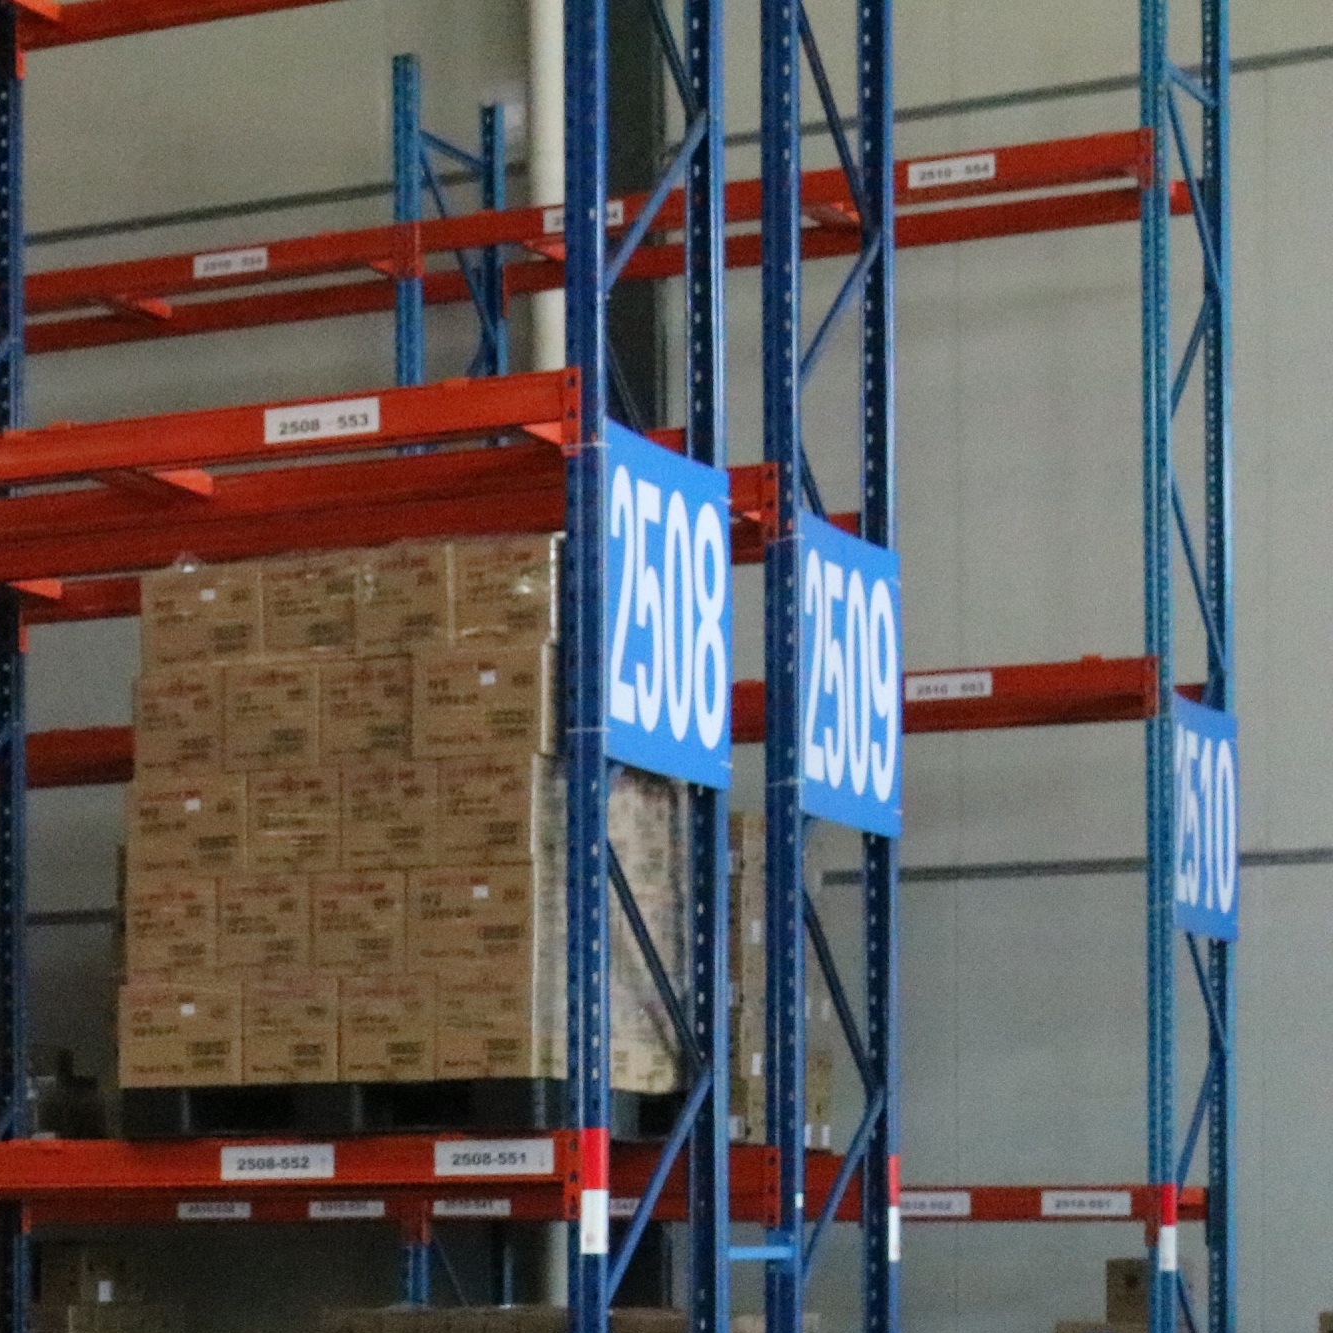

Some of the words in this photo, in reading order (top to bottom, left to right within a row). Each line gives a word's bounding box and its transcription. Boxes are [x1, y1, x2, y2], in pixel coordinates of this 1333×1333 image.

[610, 465, 726, 750] 2508
[805, 549, 897, 803] 2509
[1174, 724, 1236, 914] 2510
